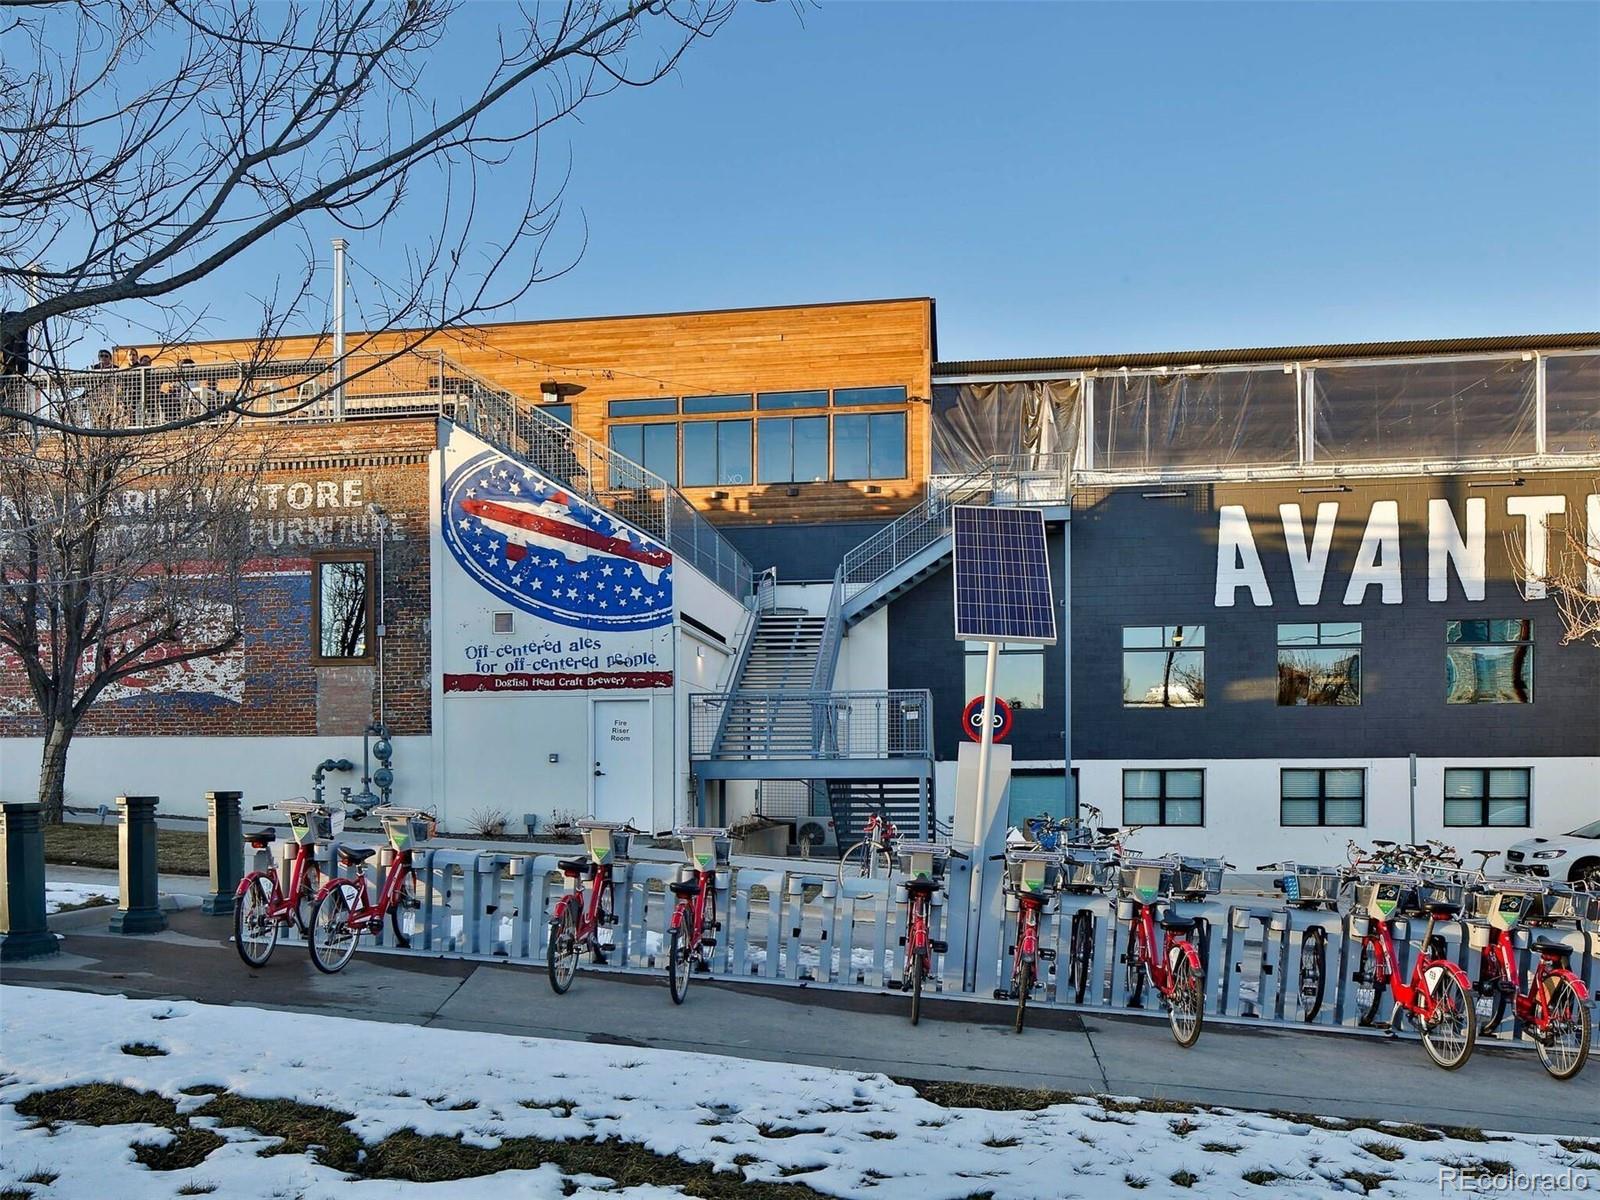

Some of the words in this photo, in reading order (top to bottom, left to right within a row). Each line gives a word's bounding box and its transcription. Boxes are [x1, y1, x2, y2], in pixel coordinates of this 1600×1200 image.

[236, 479, 363, 512] STORE
[465, 640, 562, 660] Off-centered
[569, 637, 602, 652] ales
[475, 659, 498, 673] for
[505, 656, 599, 673] off-centered
[606, 652, 660, 668] people.
[495, 678, 529, 688] Dogfish
[532, 677, 556, 687] Head
[558, 677, 583, 687] Craft
[587, 676, 627, 687] Brewery
